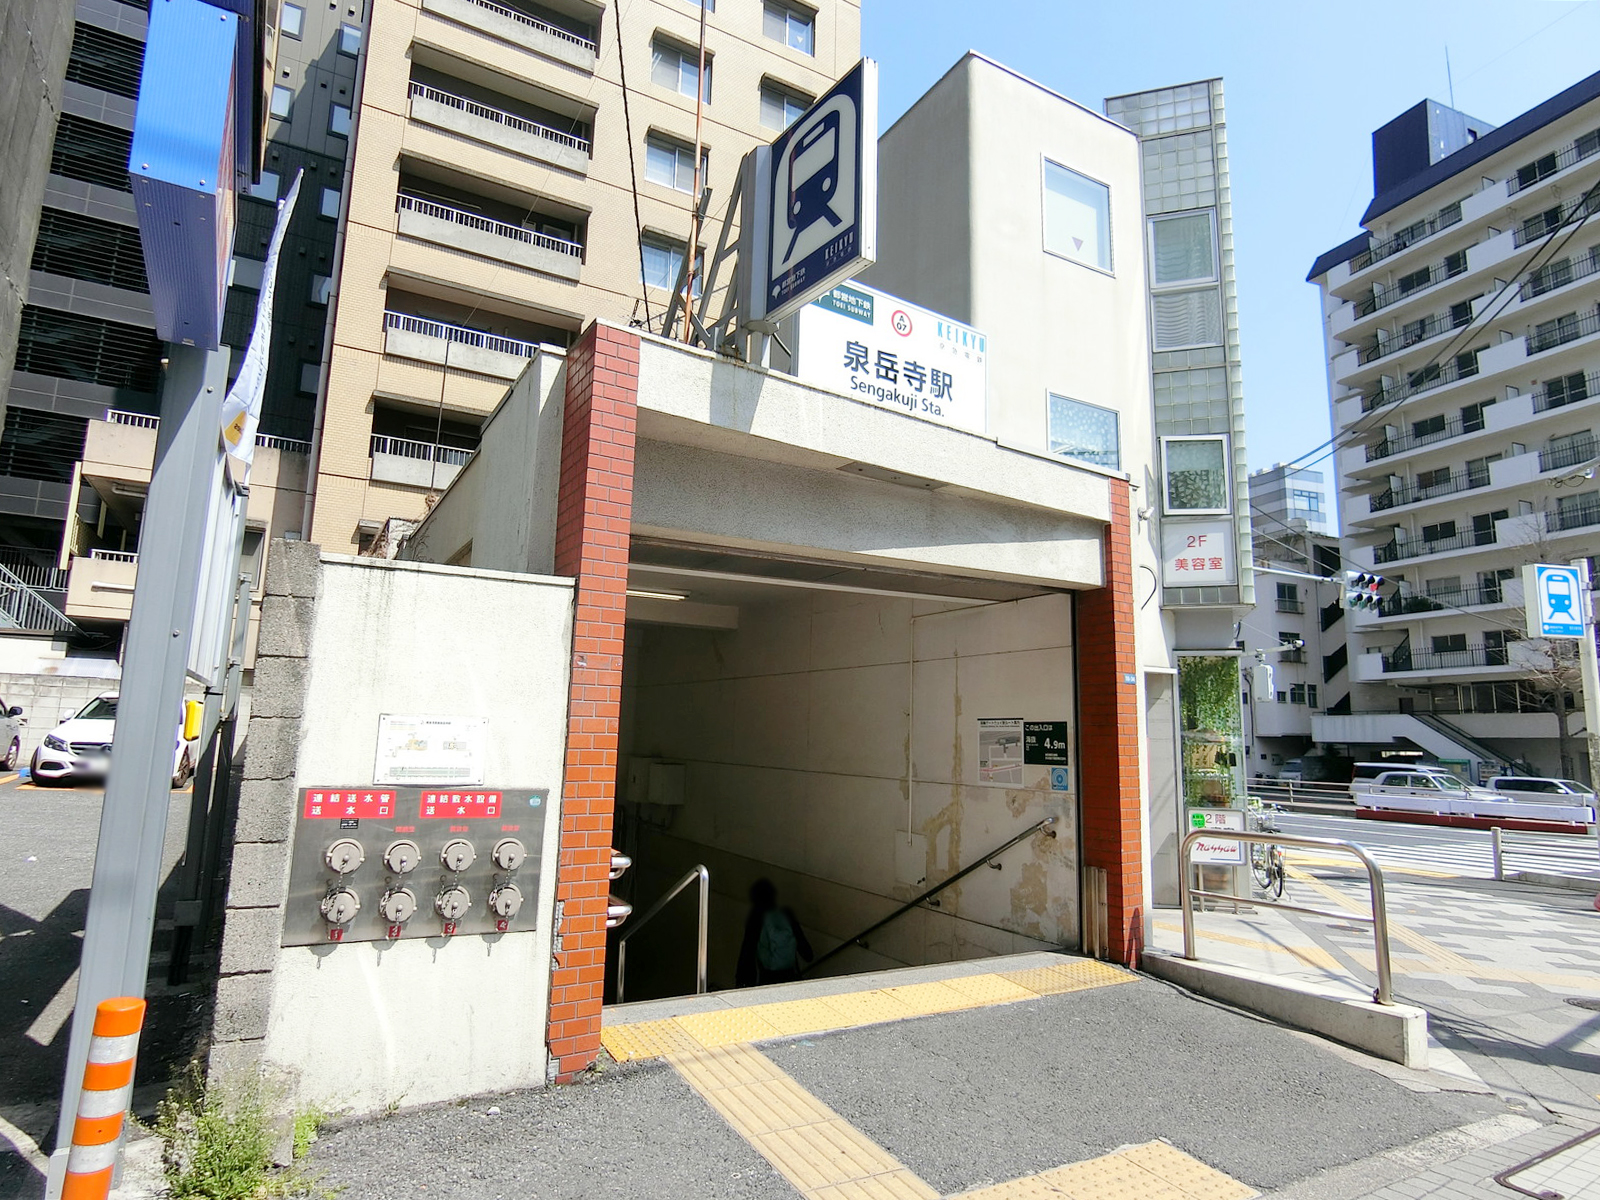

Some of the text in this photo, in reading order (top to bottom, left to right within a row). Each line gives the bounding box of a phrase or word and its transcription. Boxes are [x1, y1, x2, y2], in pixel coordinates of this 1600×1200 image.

[825, 232, 854, 260] KEIKYU
[833, 290, 871, 311] 都営地下鉄
[832, 299, 871, 319] TOEI SUBWAY
[898, 315, 905, 323] A
[896, 321, 907, 333] 07
[937, 321, 985, 353] KEIKYU
[844, 340, 953, 402] 泉岳寺駅
[851, 376, 945, 417] Sengakuji Sta.
[1187, 535, 1208, 548] 2F
[1174, 557, 1224, 571] 美容室
[1044, 737, 1066, 749] 4.9m
[312, 793, 391, 804] 連結送水管
[426, 794, 497, 805] 連結散水設備
[311, 805, 389, 815] 送水口
[426, 806, 496, 815] 送水口
